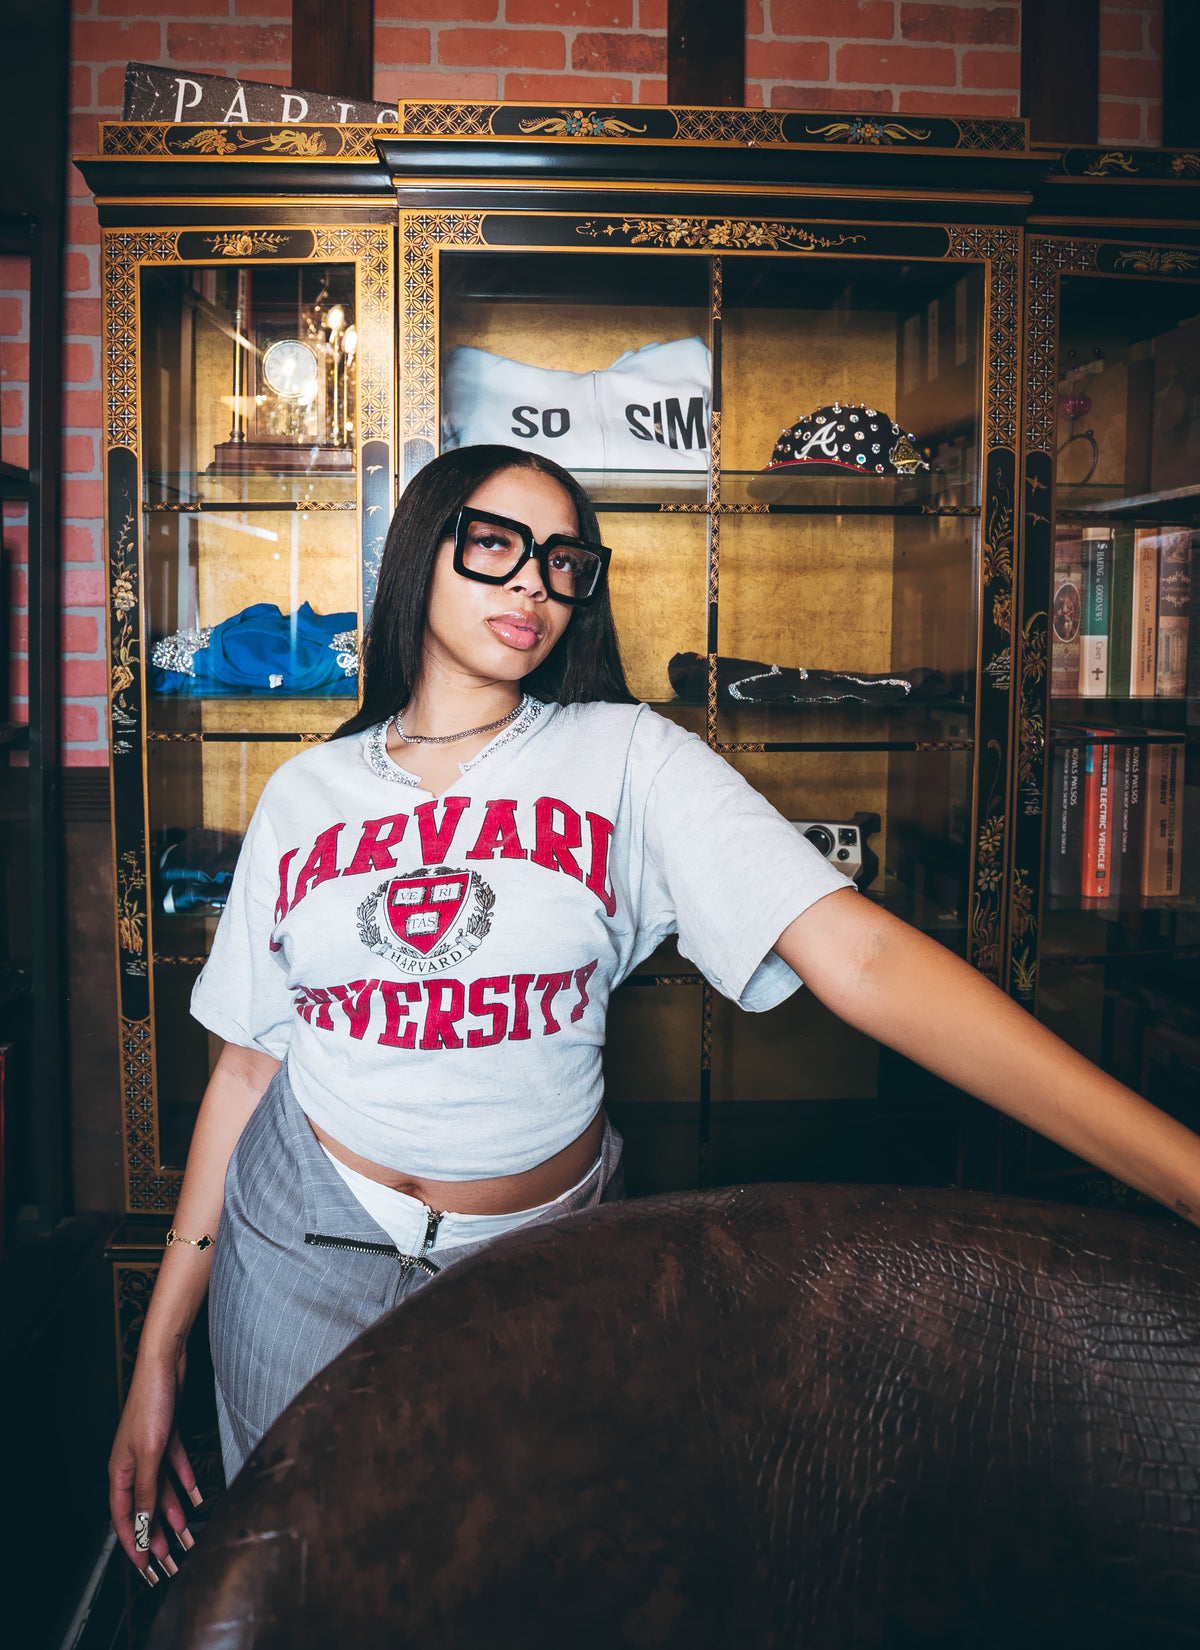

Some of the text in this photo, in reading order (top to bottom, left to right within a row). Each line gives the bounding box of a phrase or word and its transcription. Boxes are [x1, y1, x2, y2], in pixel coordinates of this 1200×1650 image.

[511, 397, 707, 450] SO SIM
[1096, 542, 1108, 576] SHARING
[1095, 584, 1104, 604] GOOD
[1095, 603, 1104, 622] NEWS
[1099, 787, 1108, 829] ELECTRIC
[1097, 831, 1106, 869] VEHICLE
[401, 887, 452, 901] VE RI
[410, 916, 436, 929] TAS
[390, 950, 462, 973] HARVARD
[294, 958, 599, 1050] IVERSITY
